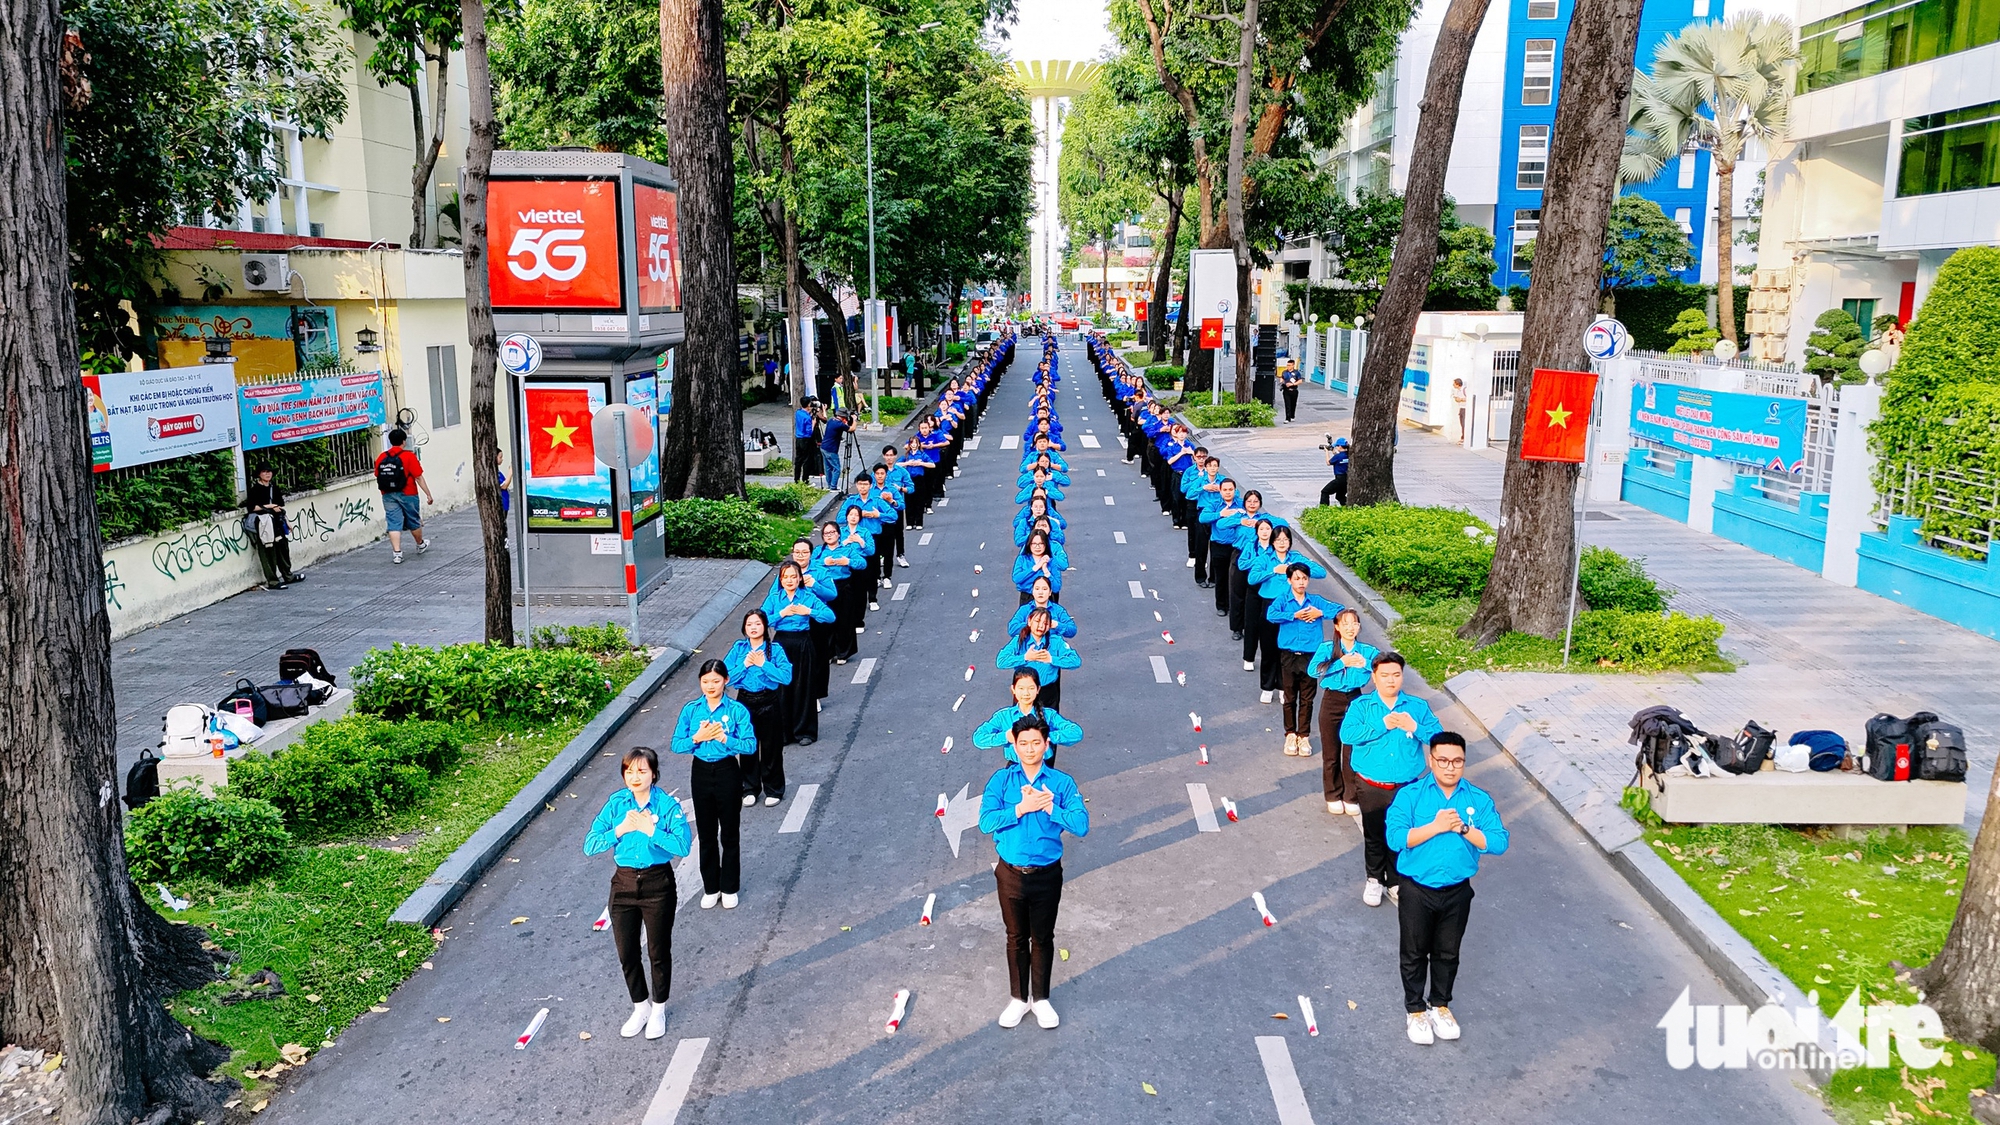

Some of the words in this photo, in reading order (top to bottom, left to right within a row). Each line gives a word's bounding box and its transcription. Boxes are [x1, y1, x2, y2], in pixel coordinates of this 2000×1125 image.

[518, 209, 585, 224] viettel
[650, 215, 669, 230] viettel
[507, 228, 587, 282] 5G
[648, 232, 670, 283] 5G
[129, 394, 140, 402] KHI
[140, 391, 153, 401] CÁC
[153, 391, 161, 400] EM
[161, 390, 168, 400] BỊ
[167, 387, 183, 399] HOẶC
[293, 399, 308, 409] SINH
[308, 396, 322, 407] NĂM
[322, 394, 338, 405] 2018
[338, 393, 345, 402] ĐI
[133, 403, 146, 414] BẠO
[158, 399, 177, 410] TRONG
[177, 397, 186, 407] VÀ
[185, 395, 202, 406] NGOÀI
[222, 392, 233, 402] HỌC
[308, 408, 324, 421] BẠCH
[162, 422, 174, 432] HÃY
[173, 421, 184, 431] GỌI
[183, 420, 193, 429] 111
[1753, 432, 1762, 446] CHÍ
[1763, 435, 1779, 449] MINH
